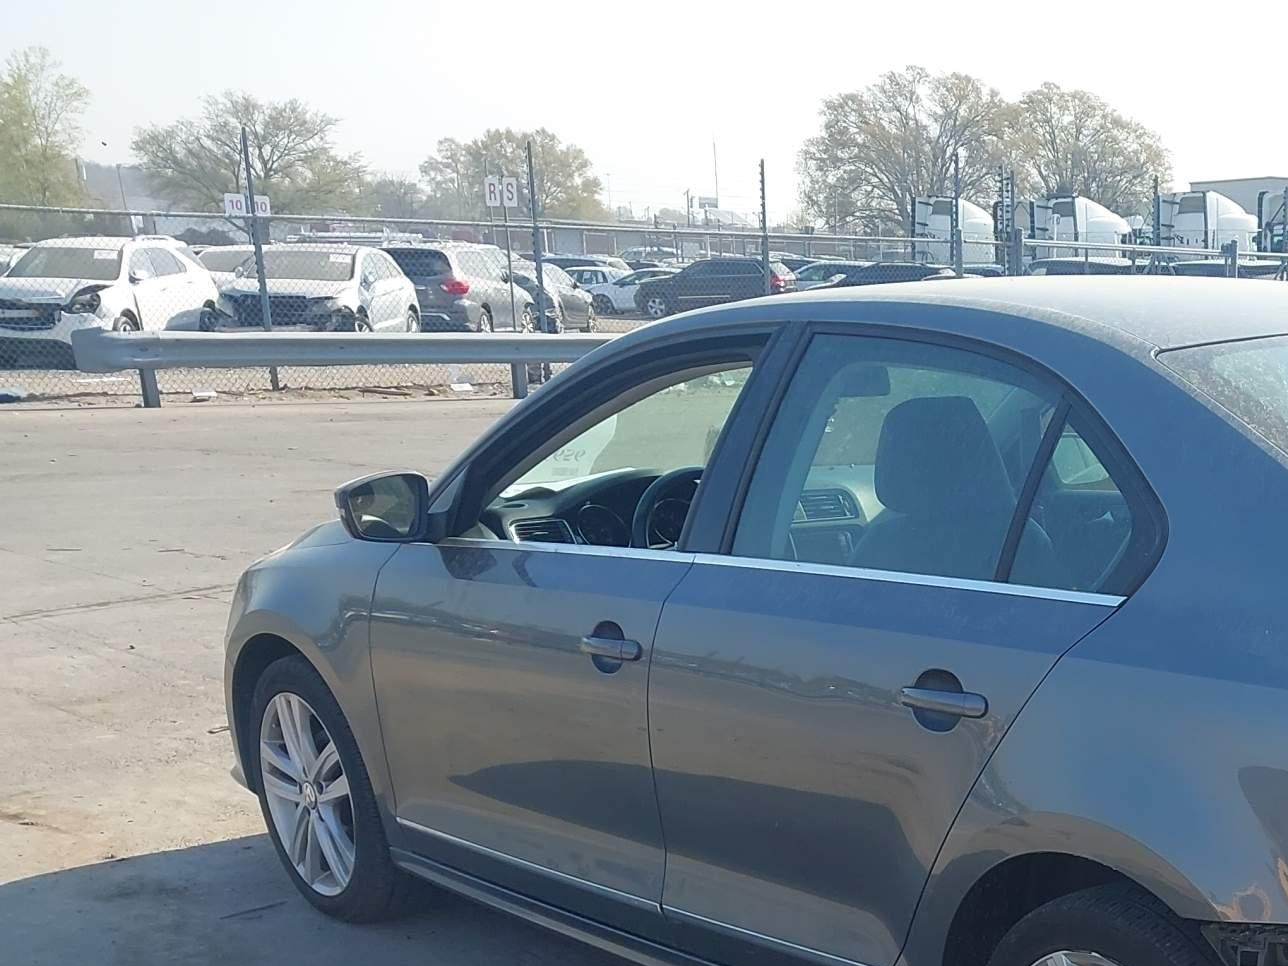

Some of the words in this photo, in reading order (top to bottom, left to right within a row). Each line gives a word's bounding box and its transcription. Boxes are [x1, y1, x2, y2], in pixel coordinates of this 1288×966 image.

[488, 183, 497, 201] R
[506, 182, 514, 202] S
[229, 199, 243, 210] 10
[254, 201, 267, 213] 10
